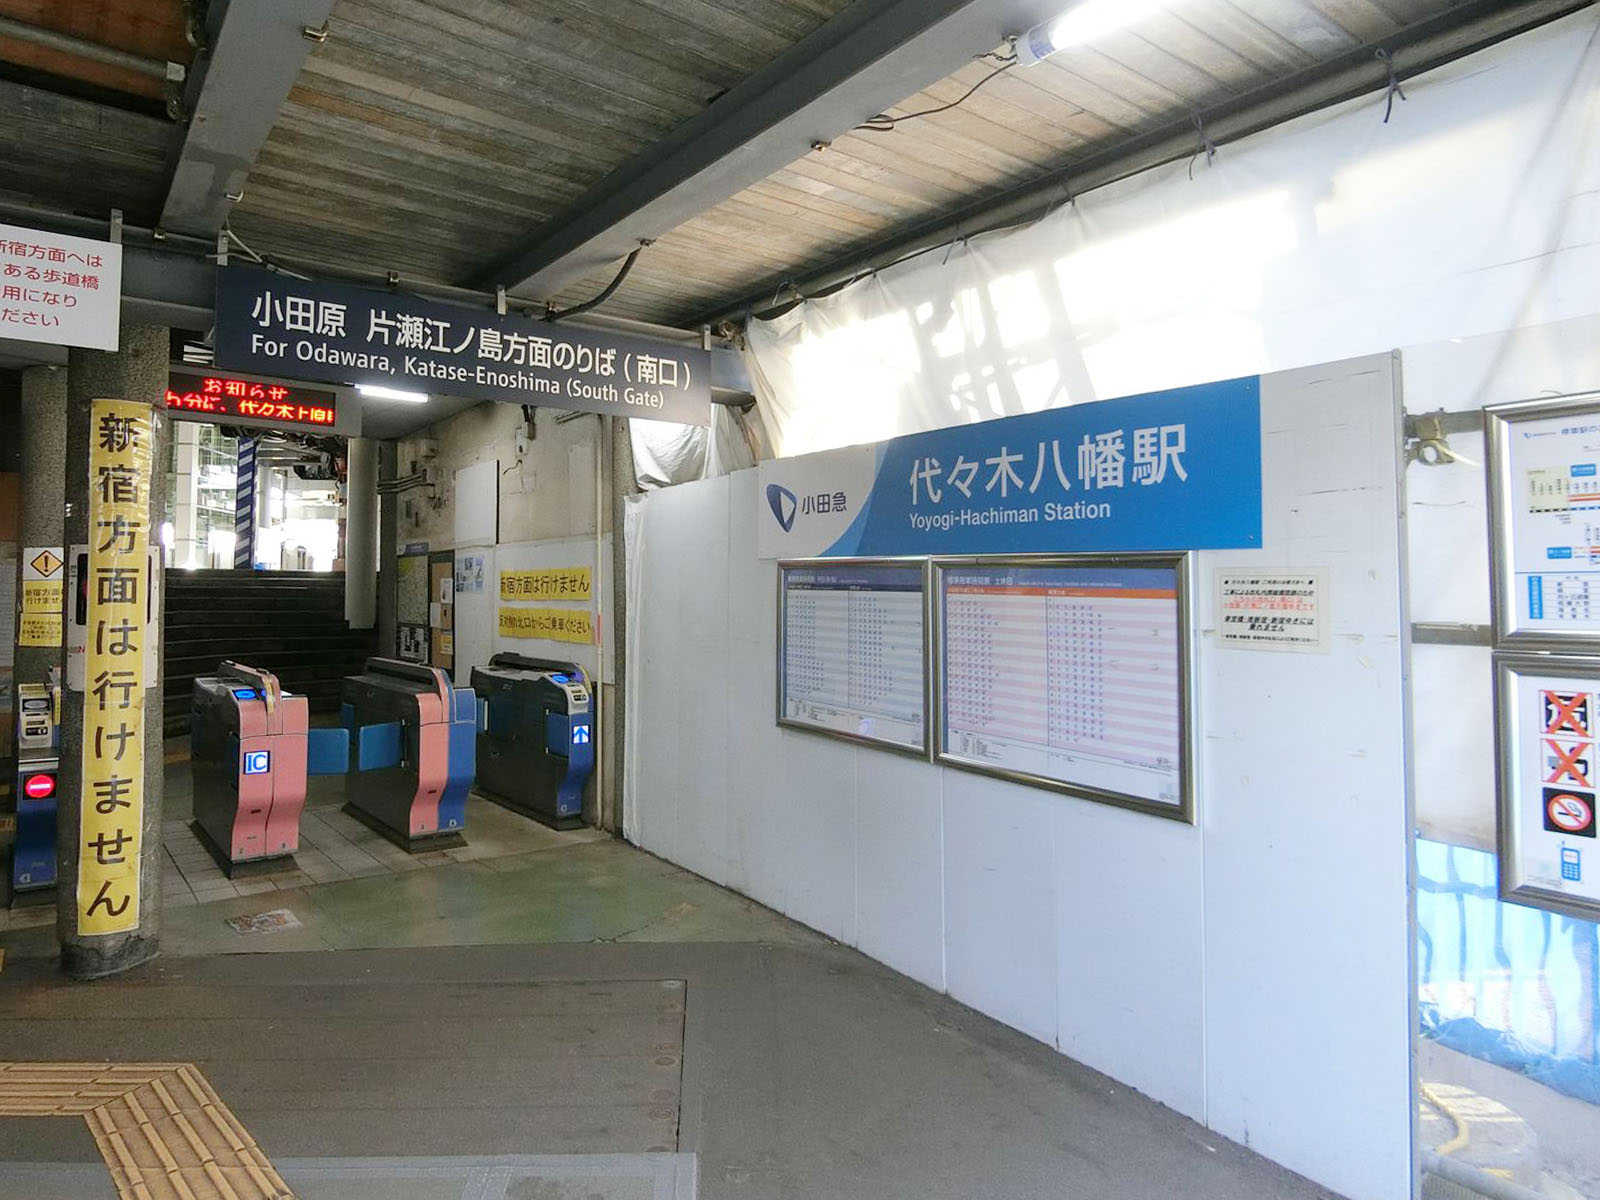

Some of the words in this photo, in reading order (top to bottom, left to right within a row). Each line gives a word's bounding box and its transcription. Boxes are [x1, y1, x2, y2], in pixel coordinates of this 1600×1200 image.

[4, 263, 100, 290] ある歩道橋
[252, 291, 346, 338] 小田原
[252, 333, 288, 357] For
[296, 340, 396, 375] Odawara,
[405, 355, 560, 395] Katase-Enoshima
[566, 377, 618, 403] (South
[624, 387, 664, 409] Gate)
[204, 378, 288, 400] お知らせ
[910, 423, 1189, 506] 代々木八幡駅
[801, 491, 848, 515] 小田急
[909, 507, 1039, 532] Yoyogi-Hachiman
[1044, 501, 1111, 522] Station
[86, 412, 141, 918] 新宿方面は行けません
[247, 753, 266, 772] IC
